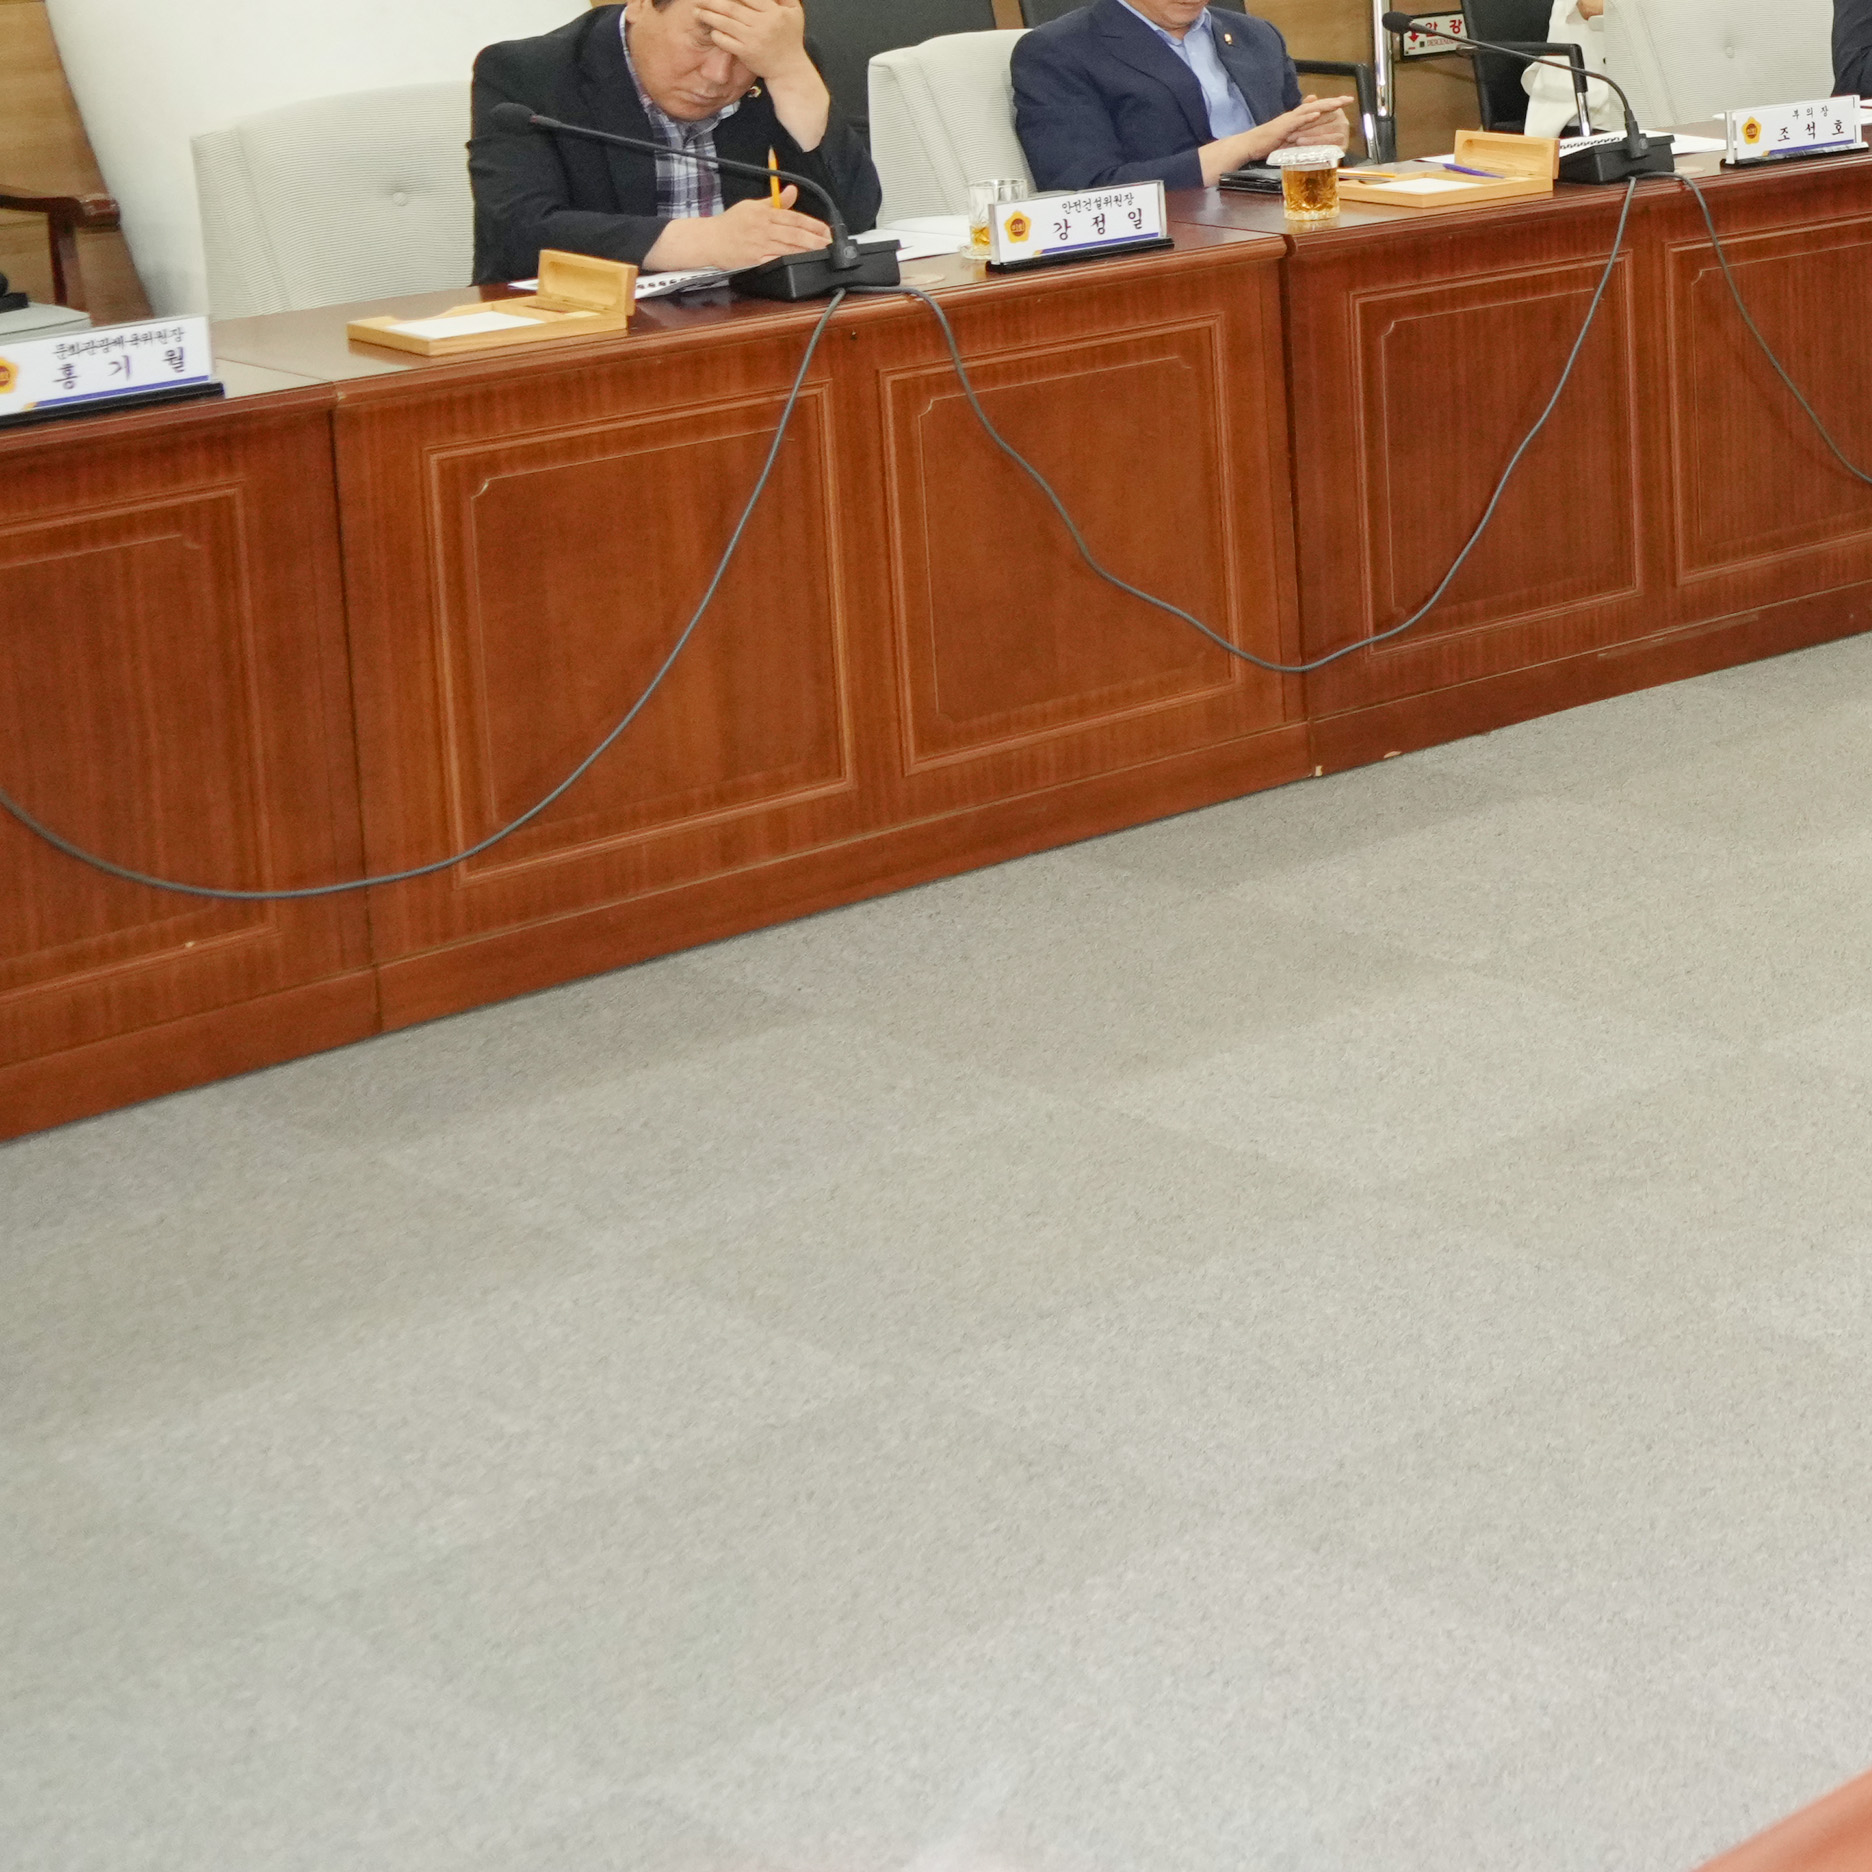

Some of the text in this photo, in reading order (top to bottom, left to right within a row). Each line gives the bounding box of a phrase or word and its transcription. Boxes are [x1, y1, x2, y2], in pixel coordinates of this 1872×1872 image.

[1792, 105, 1829, 120] 부의장
[1777, 119, 1845, 142] 조석호
[1061, 192, 1135, 215] 안전건설위원장
[1053, 207, 1143, 241] 강정일
[52, 346, 186, 390] 홍기월
